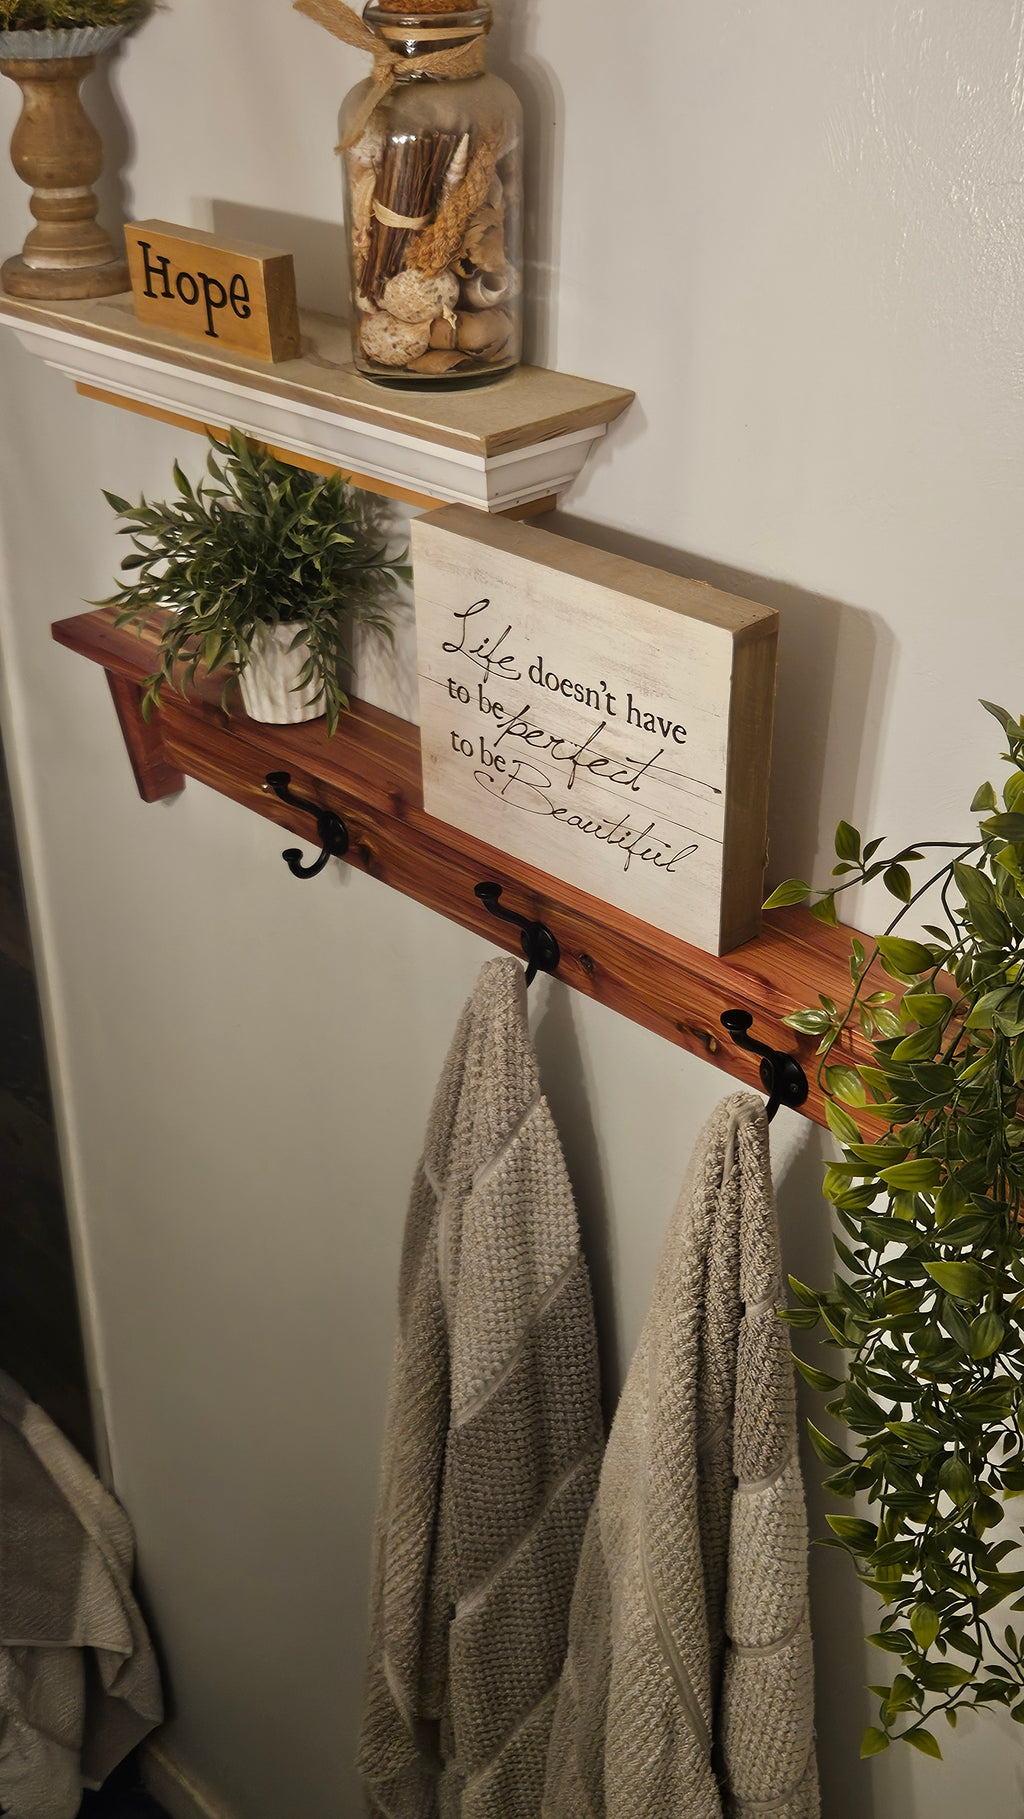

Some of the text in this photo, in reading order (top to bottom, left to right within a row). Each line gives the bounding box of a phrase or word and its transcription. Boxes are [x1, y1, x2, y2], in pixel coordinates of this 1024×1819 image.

[137, 241, 251, 338] Hope
[442, 598, 687, 745] Life doesn't have
[447, 677, 722, 794] to be perfect
[450, 729, 698, 874] to be Beautiful
